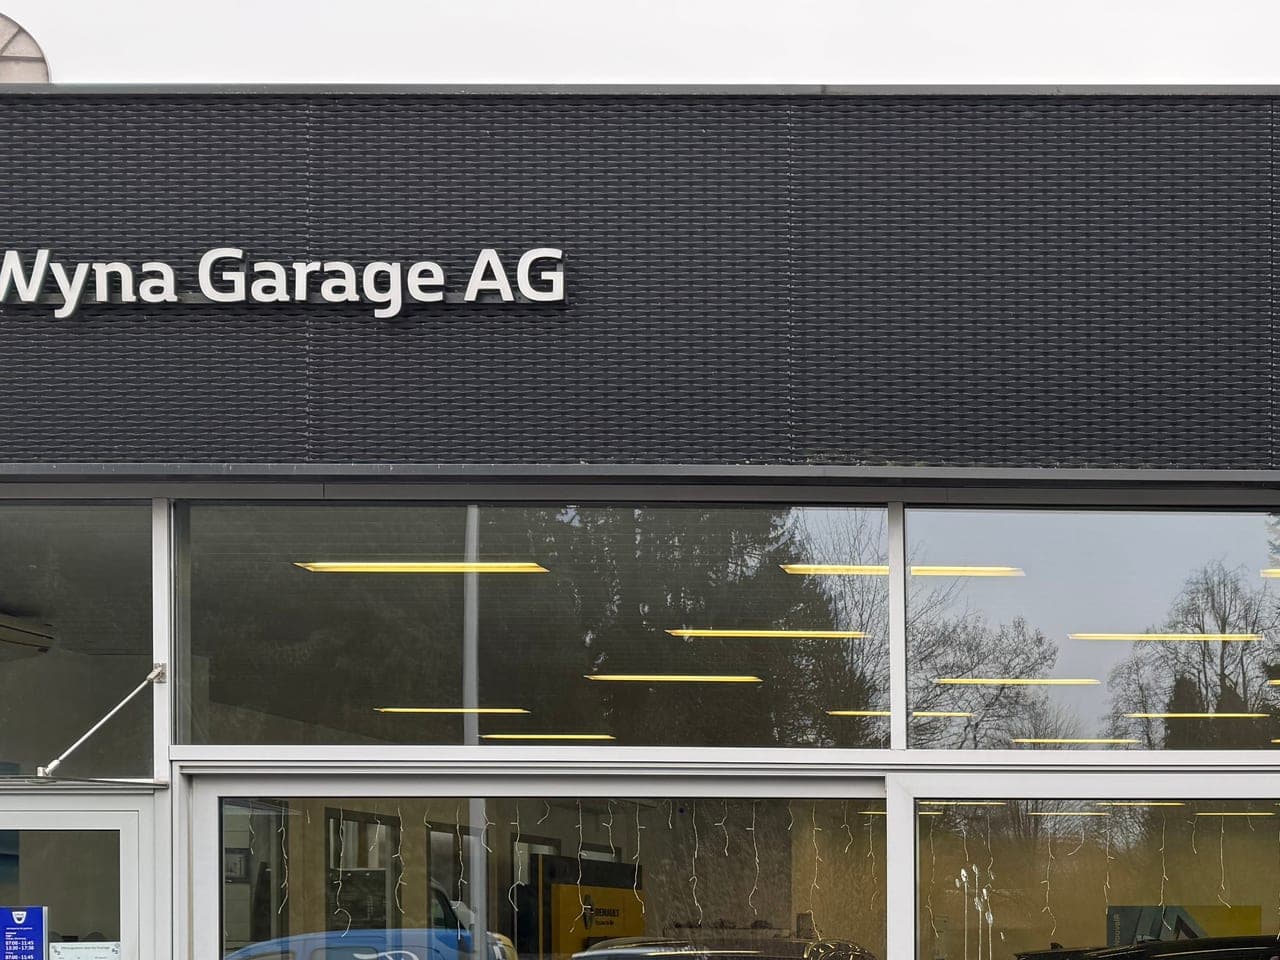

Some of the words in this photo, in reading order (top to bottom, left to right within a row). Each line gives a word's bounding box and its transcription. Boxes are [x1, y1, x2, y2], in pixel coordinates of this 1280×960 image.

[0, 248, 178, 318] Wyna
[198, 247, 444, 318] Garage
[463, 247, 565, 302] AG
